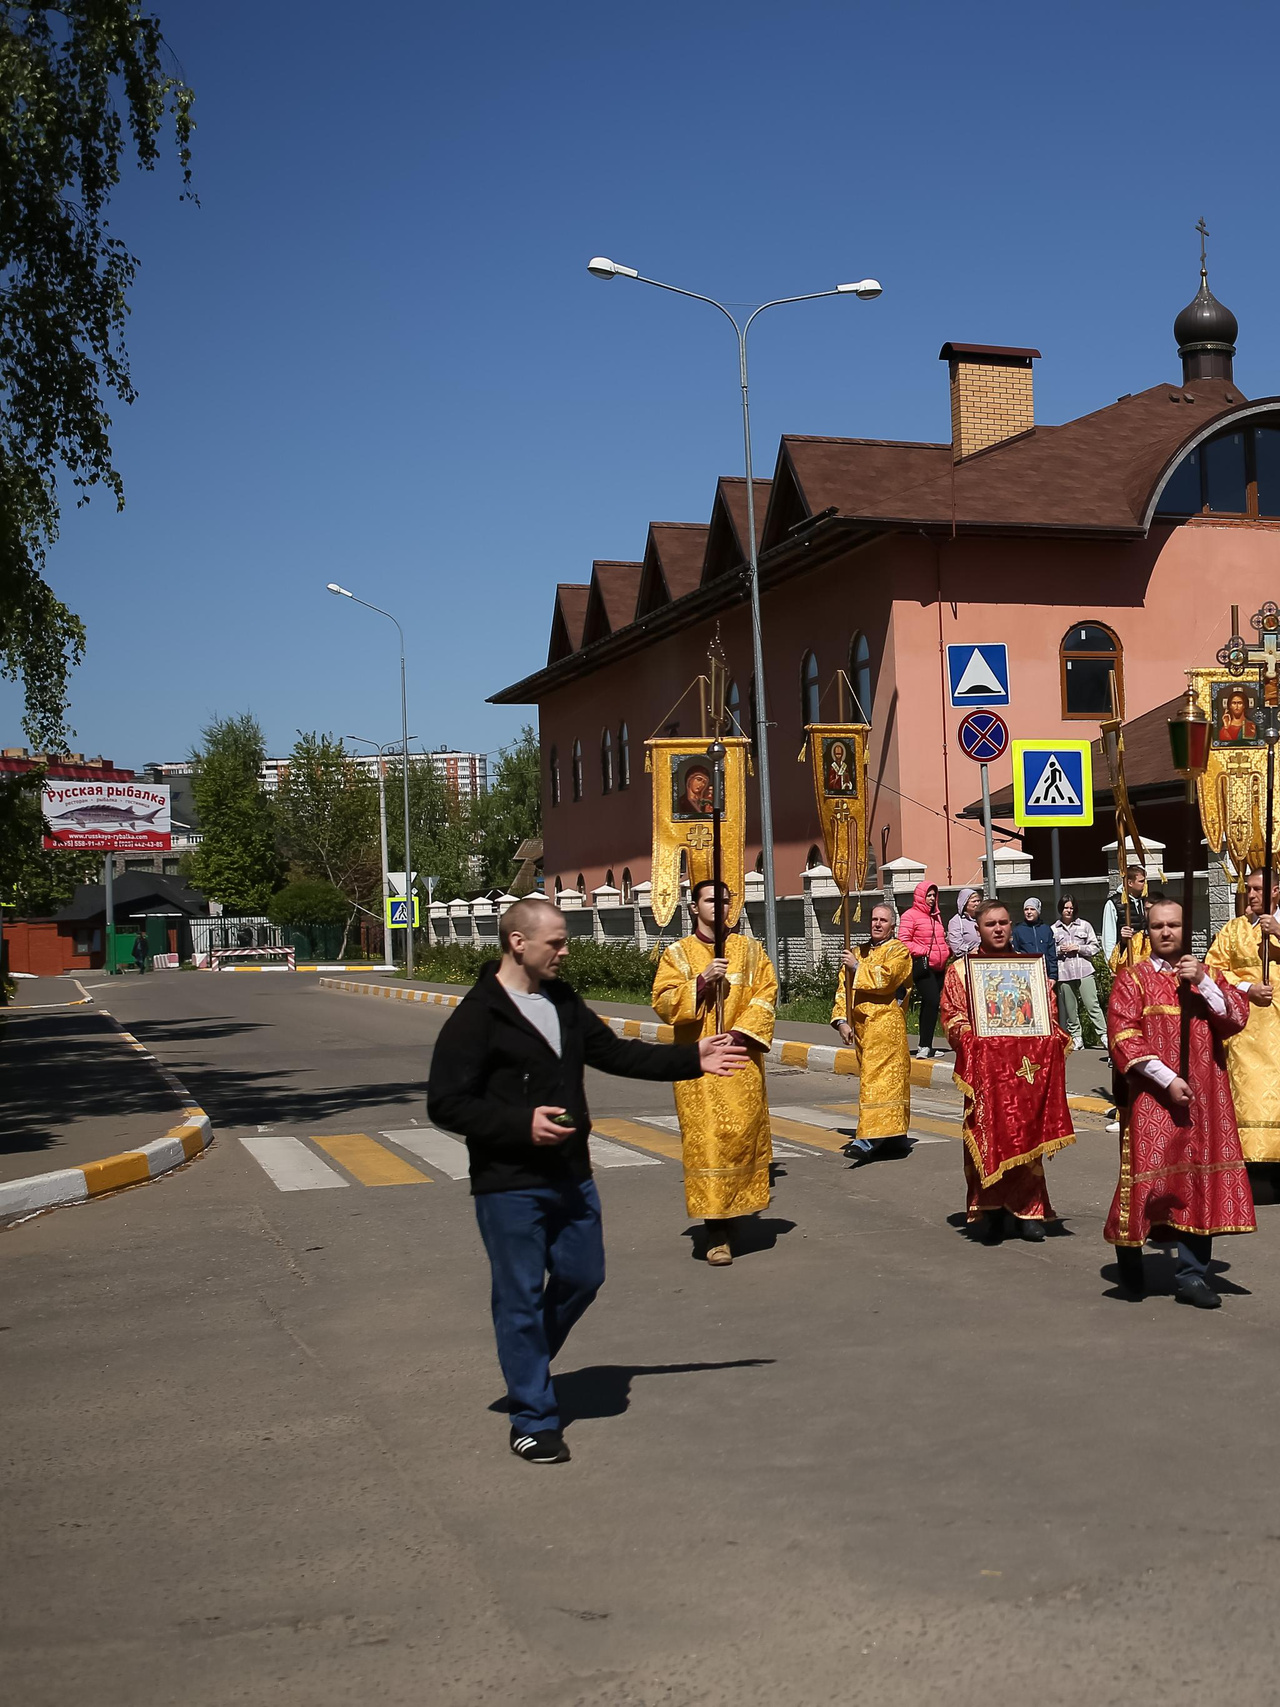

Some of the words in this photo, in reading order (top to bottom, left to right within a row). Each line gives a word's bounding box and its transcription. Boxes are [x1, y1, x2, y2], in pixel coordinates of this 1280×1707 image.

[47, 786, 103, 803] Русская
[107, 786, 166, 806] рыбалка
[65, 799, 88, 807] ресторан
